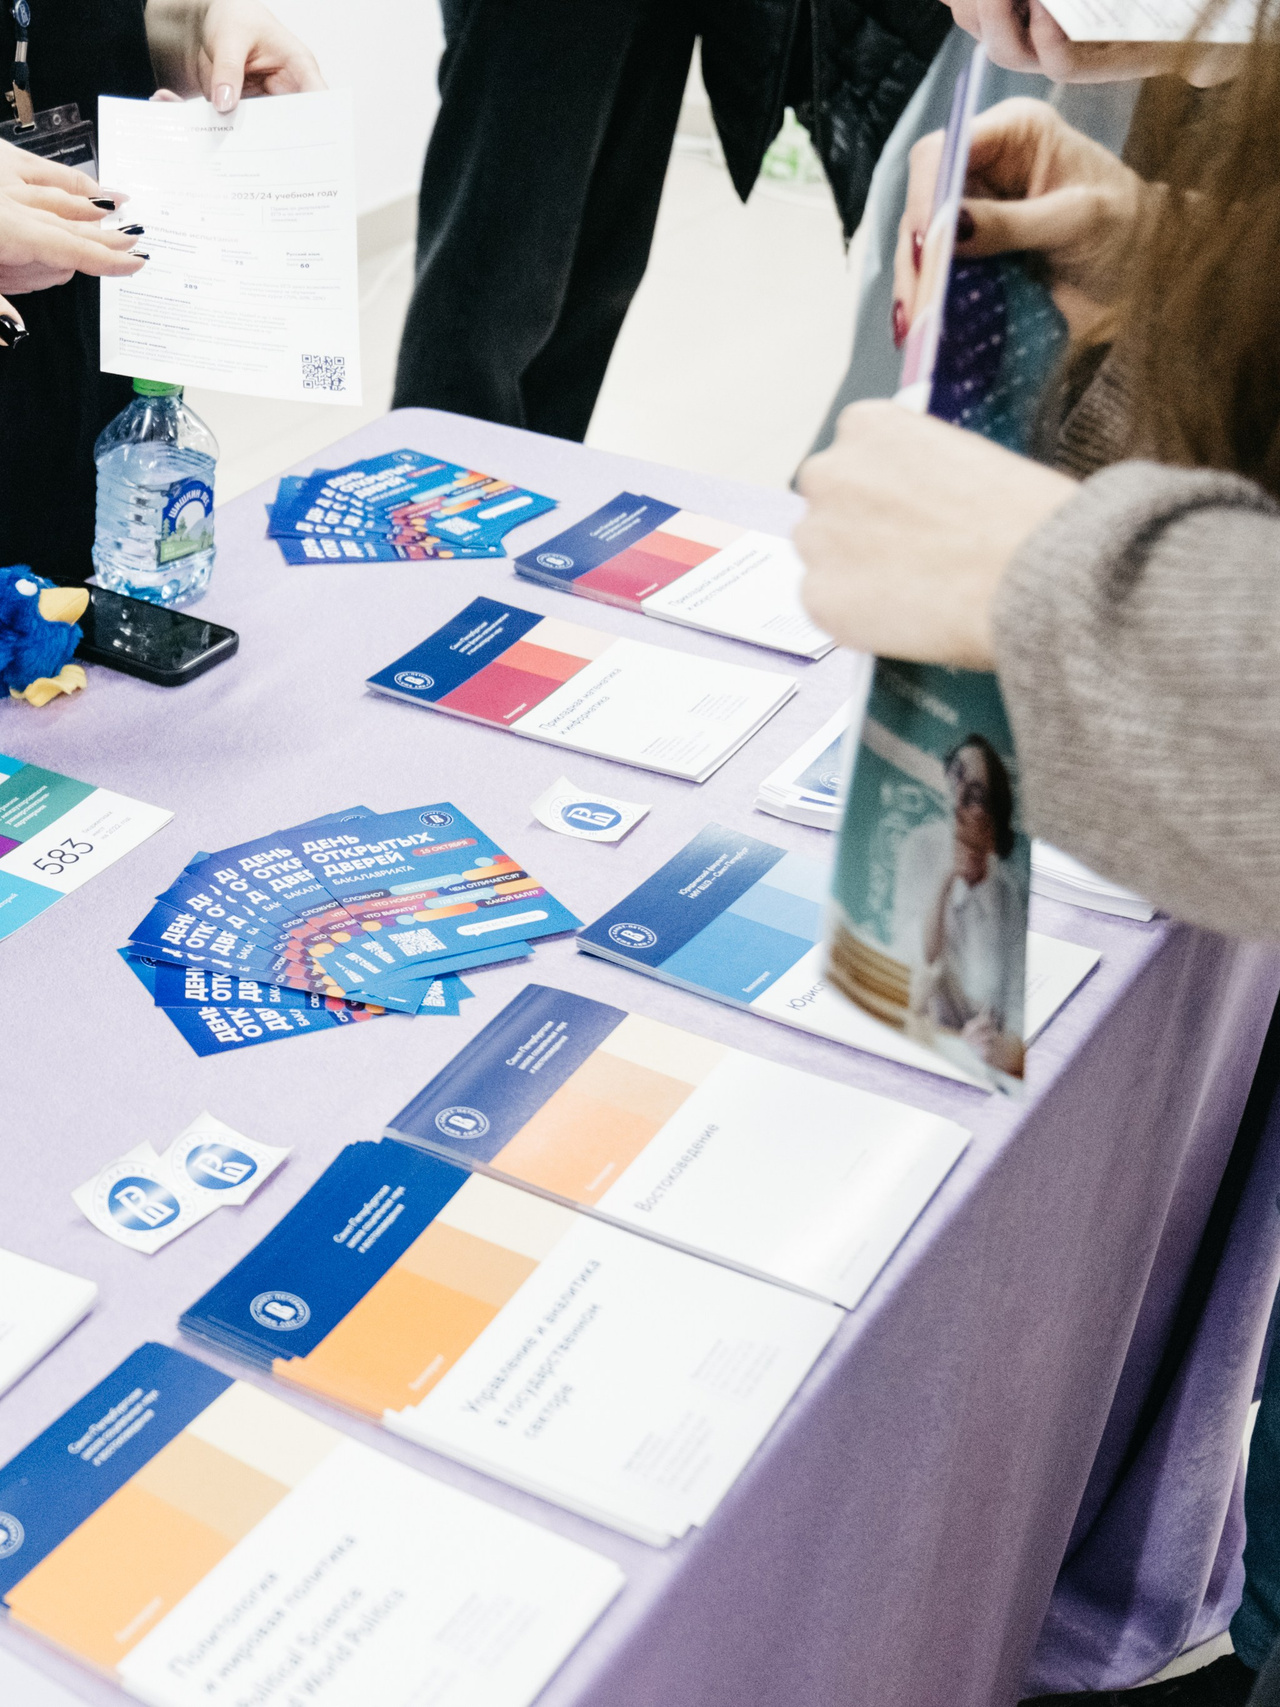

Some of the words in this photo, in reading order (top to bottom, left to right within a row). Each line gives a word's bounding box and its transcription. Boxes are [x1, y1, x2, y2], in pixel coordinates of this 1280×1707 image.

[231, 191, 272, 201] 2023/24
[274, 191, 314, 202] учебном
[316, 189, 339, 199] году
[537, 698, 584, 730] Прикладная
[581, 667, 622, 698] математика
[301, 834, 360, 855] ДЕНЬ
[311, 832, 435, 863] ОТКРЫТЫХ
[431, 840, 469, 853] ОКТЯБРЯ
[32, 837, 94, 875] 583
[238, 847, 293, 872] ДЕНЬ
[322, 850, 405, 878] ДВЕРЕЙ
[252, 857, 303, 879] ОТКР
[332, 865, 415, 885] БАКАЛАВРИАТА
[449, 884, 465, 892] ЧЕМ
[466, 873, 520, 889] ОТЛИЧАЕТСЯ?
[342, 891, 384, 903] СЛОЖНО?
[389, 893, 427, 905] НОВОГО?
[485, 894, 514, 906] КАКОЙ
[363, 912, 381, 920] ЧТО
[382, 905, 418, 917] ВЫБРАТЬ?
[632, 1122, 720, 1212] Востоковедение
[460, 1334, 538, 1414] Управление
[541, 1259, 602, 1324] аналитика
[296, 1585, 363, 1648] Science
